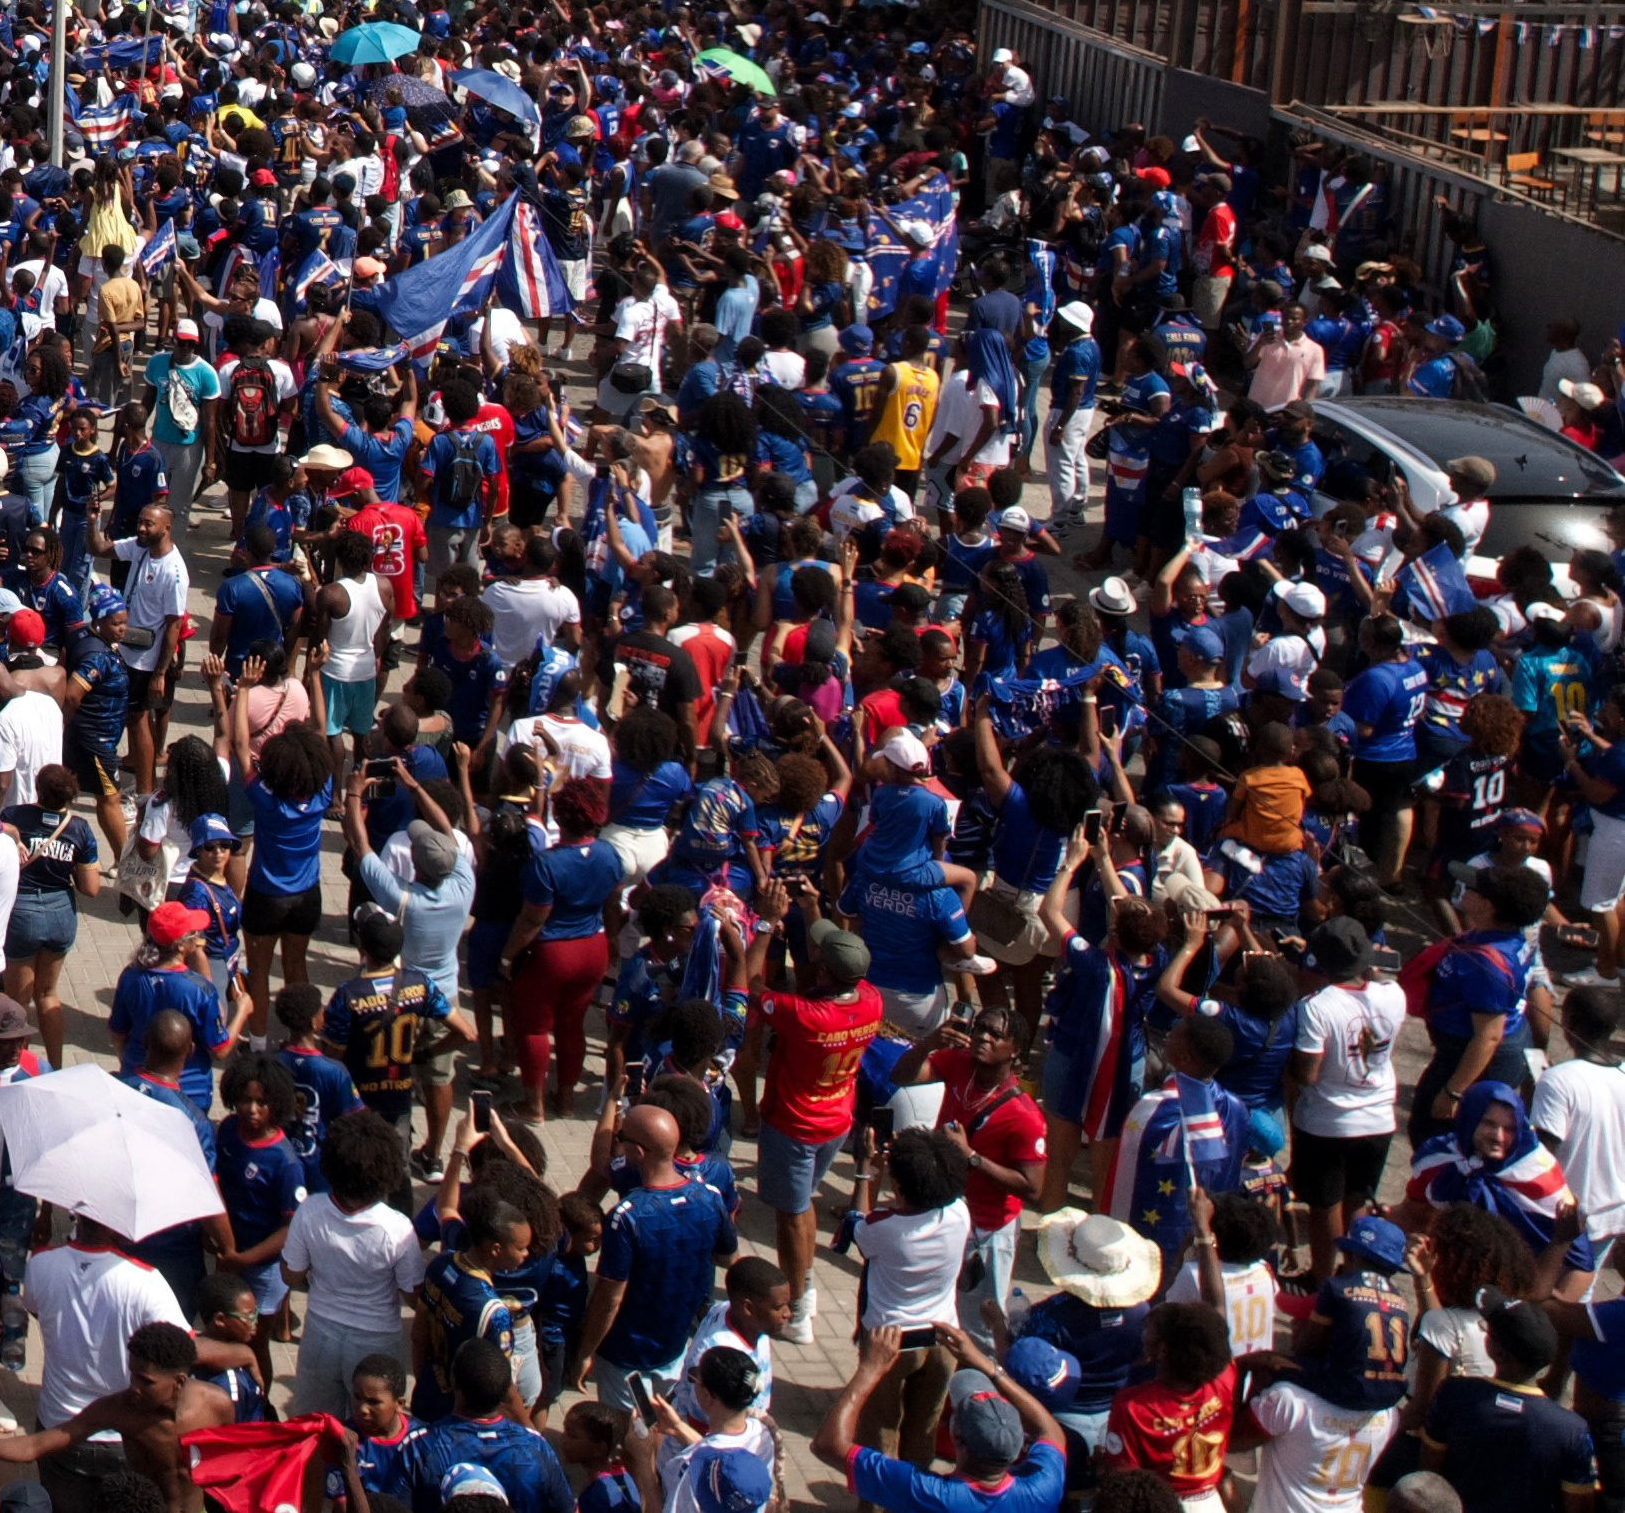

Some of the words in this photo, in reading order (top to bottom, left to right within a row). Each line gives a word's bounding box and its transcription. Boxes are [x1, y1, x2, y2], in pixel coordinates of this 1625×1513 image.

[904, 402, 921, 428] 6
[1551, 682, 1584, 720] 10
[1472, 770, 1505, 809] 10
[864, 892, 917, 918] VERDE
[869, 883, 914, 903] CABO
[367, 1013, 419, 1068] 10
[818, 1031, 847, 1044] CABO
[1231, 1294, 1268, 1344] 10
[1365, 1311, 1407, 1365] 11
[1312, 1441, 1371, 1488] 10
